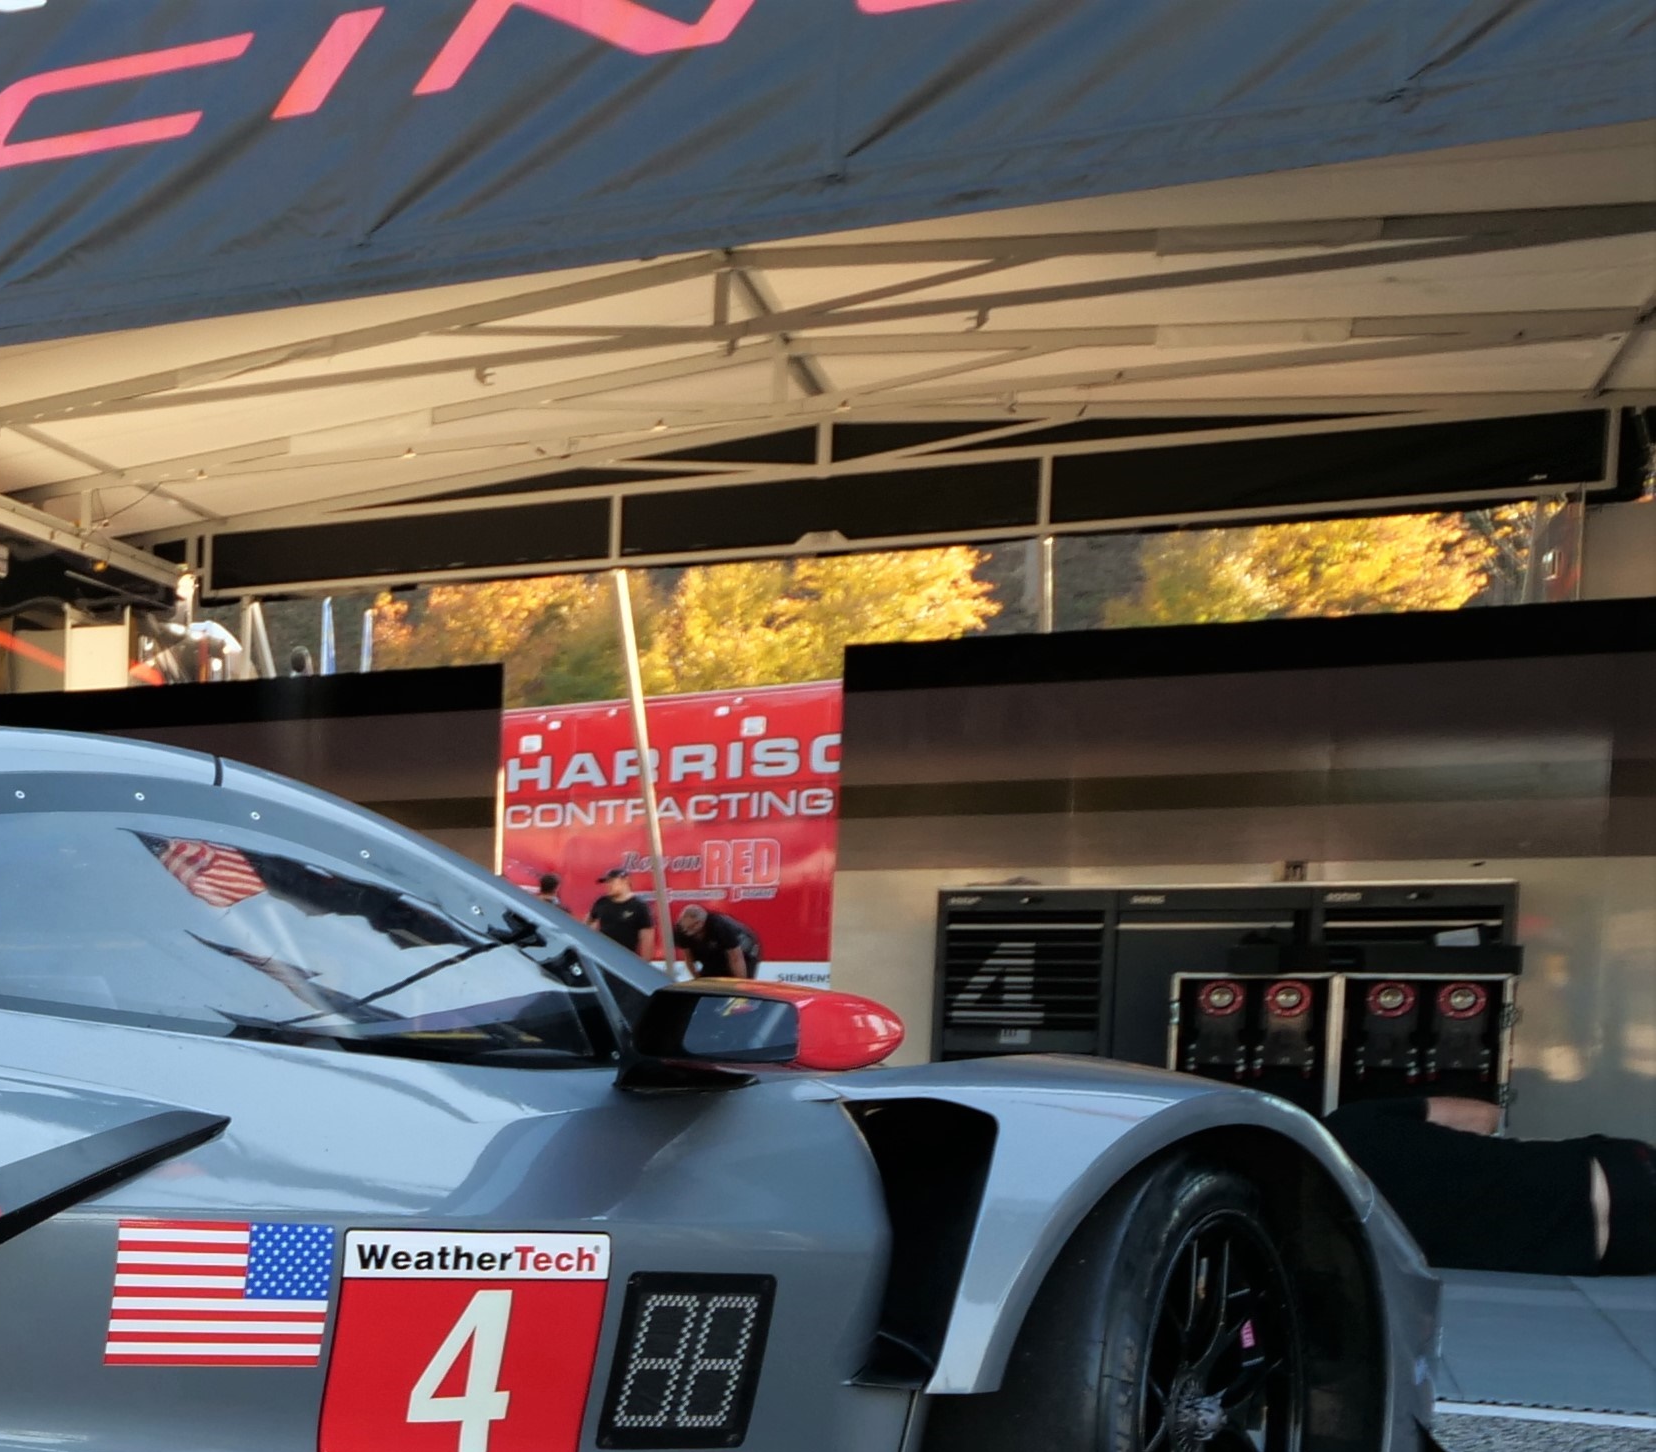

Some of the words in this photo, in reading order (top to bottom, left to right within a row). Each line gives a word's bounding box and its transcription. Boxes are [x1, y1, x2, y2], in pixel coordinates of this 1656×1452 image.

[505, 788, 835, 830] CONTRACTING
[701, 838, 782, 888] RED
[356, 1243, 597, 1273] WeatherTech
